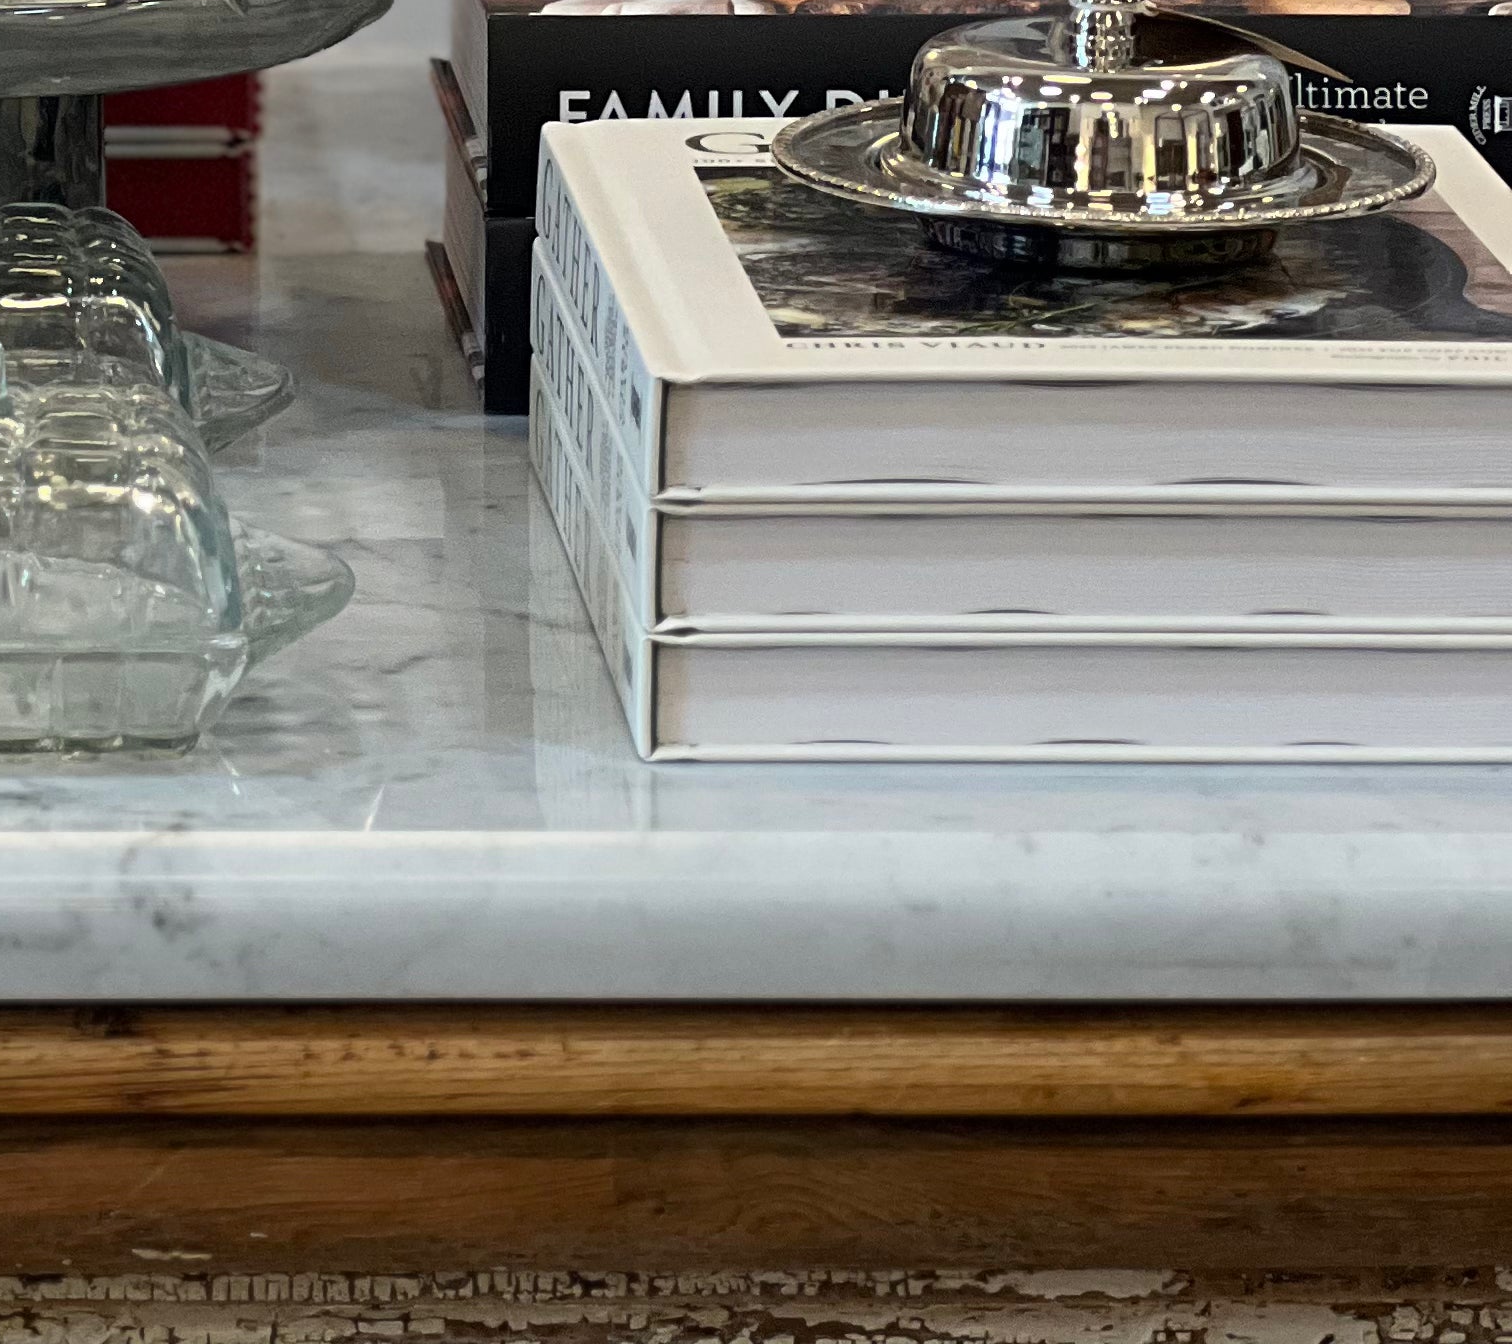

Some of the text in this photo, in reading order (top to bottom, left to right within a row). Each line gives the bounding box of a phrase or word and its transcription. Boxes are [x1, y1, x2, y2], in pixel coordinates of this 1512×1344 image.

[1289, 72, 1429, 110] ltimate
[543, 157, 600, 359] GATHER
[536, 273, 595, 481] GATHER
